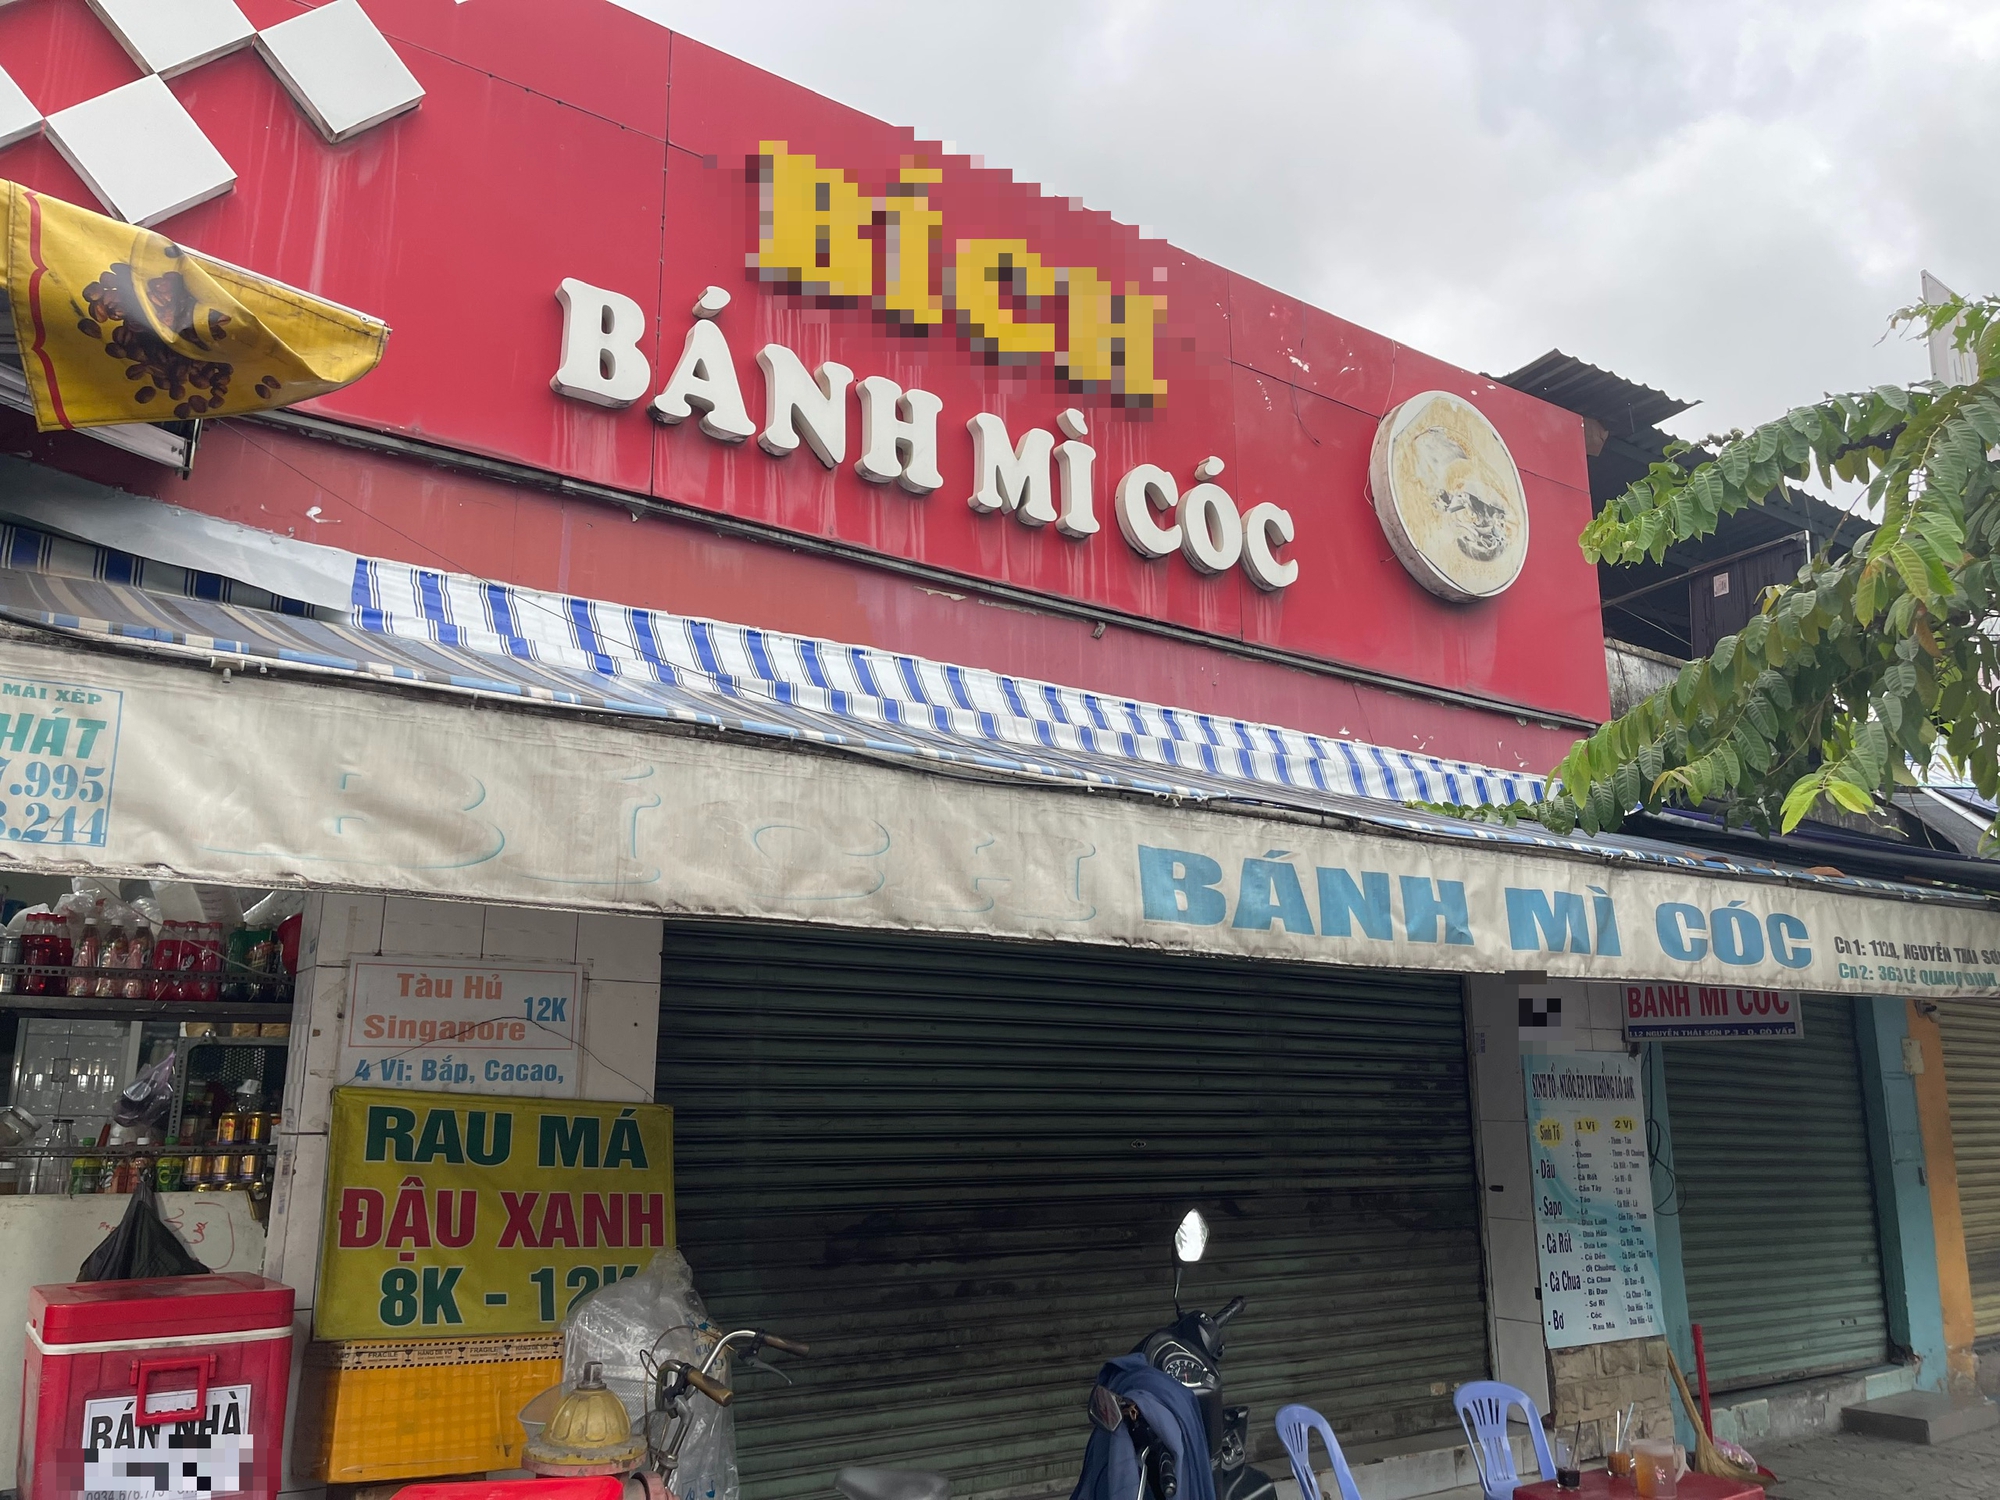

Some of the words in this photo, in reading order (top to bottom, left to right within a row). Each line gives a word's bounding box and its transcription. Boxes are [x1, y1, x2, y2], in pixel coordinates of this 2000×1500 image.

[550, 277, 943, 495] BÁNH
[966, 409, 1100, 538] MÌ
[1116, 456, 1298, 591] CÓC
[2, 682, 47, 700] MÁI
[1137, 844, 1473, 947] BÁNH
[1505, 884, 1623, 958] MÌ
[1655, 899, 1814, 969] CÓC
[1981, 948, 2000, 965] SƠ
[397, 972, 453, 1000] Tàu
[464, 972, 503, 1000] Hủ
[523, 996, 567, 1023] 12K
[363, 1013, 526, 1044] Singapore
[356, 1058, 371, 1082] 4
[421, 1054, 475, 1085] Bắp,
[484, 1058, 565, 1084] Cacao,
[364, 1105, 513, 1167] RAU
[537, 1108, 650, 1170] MÁ
[338, 1176, 477, 1263] ĐẬU
[497, 1190, 665, 1249] XANH
[1543, 1196, 1563, 1219] Sapo
[379, 1265, 464, 1327] 8K
